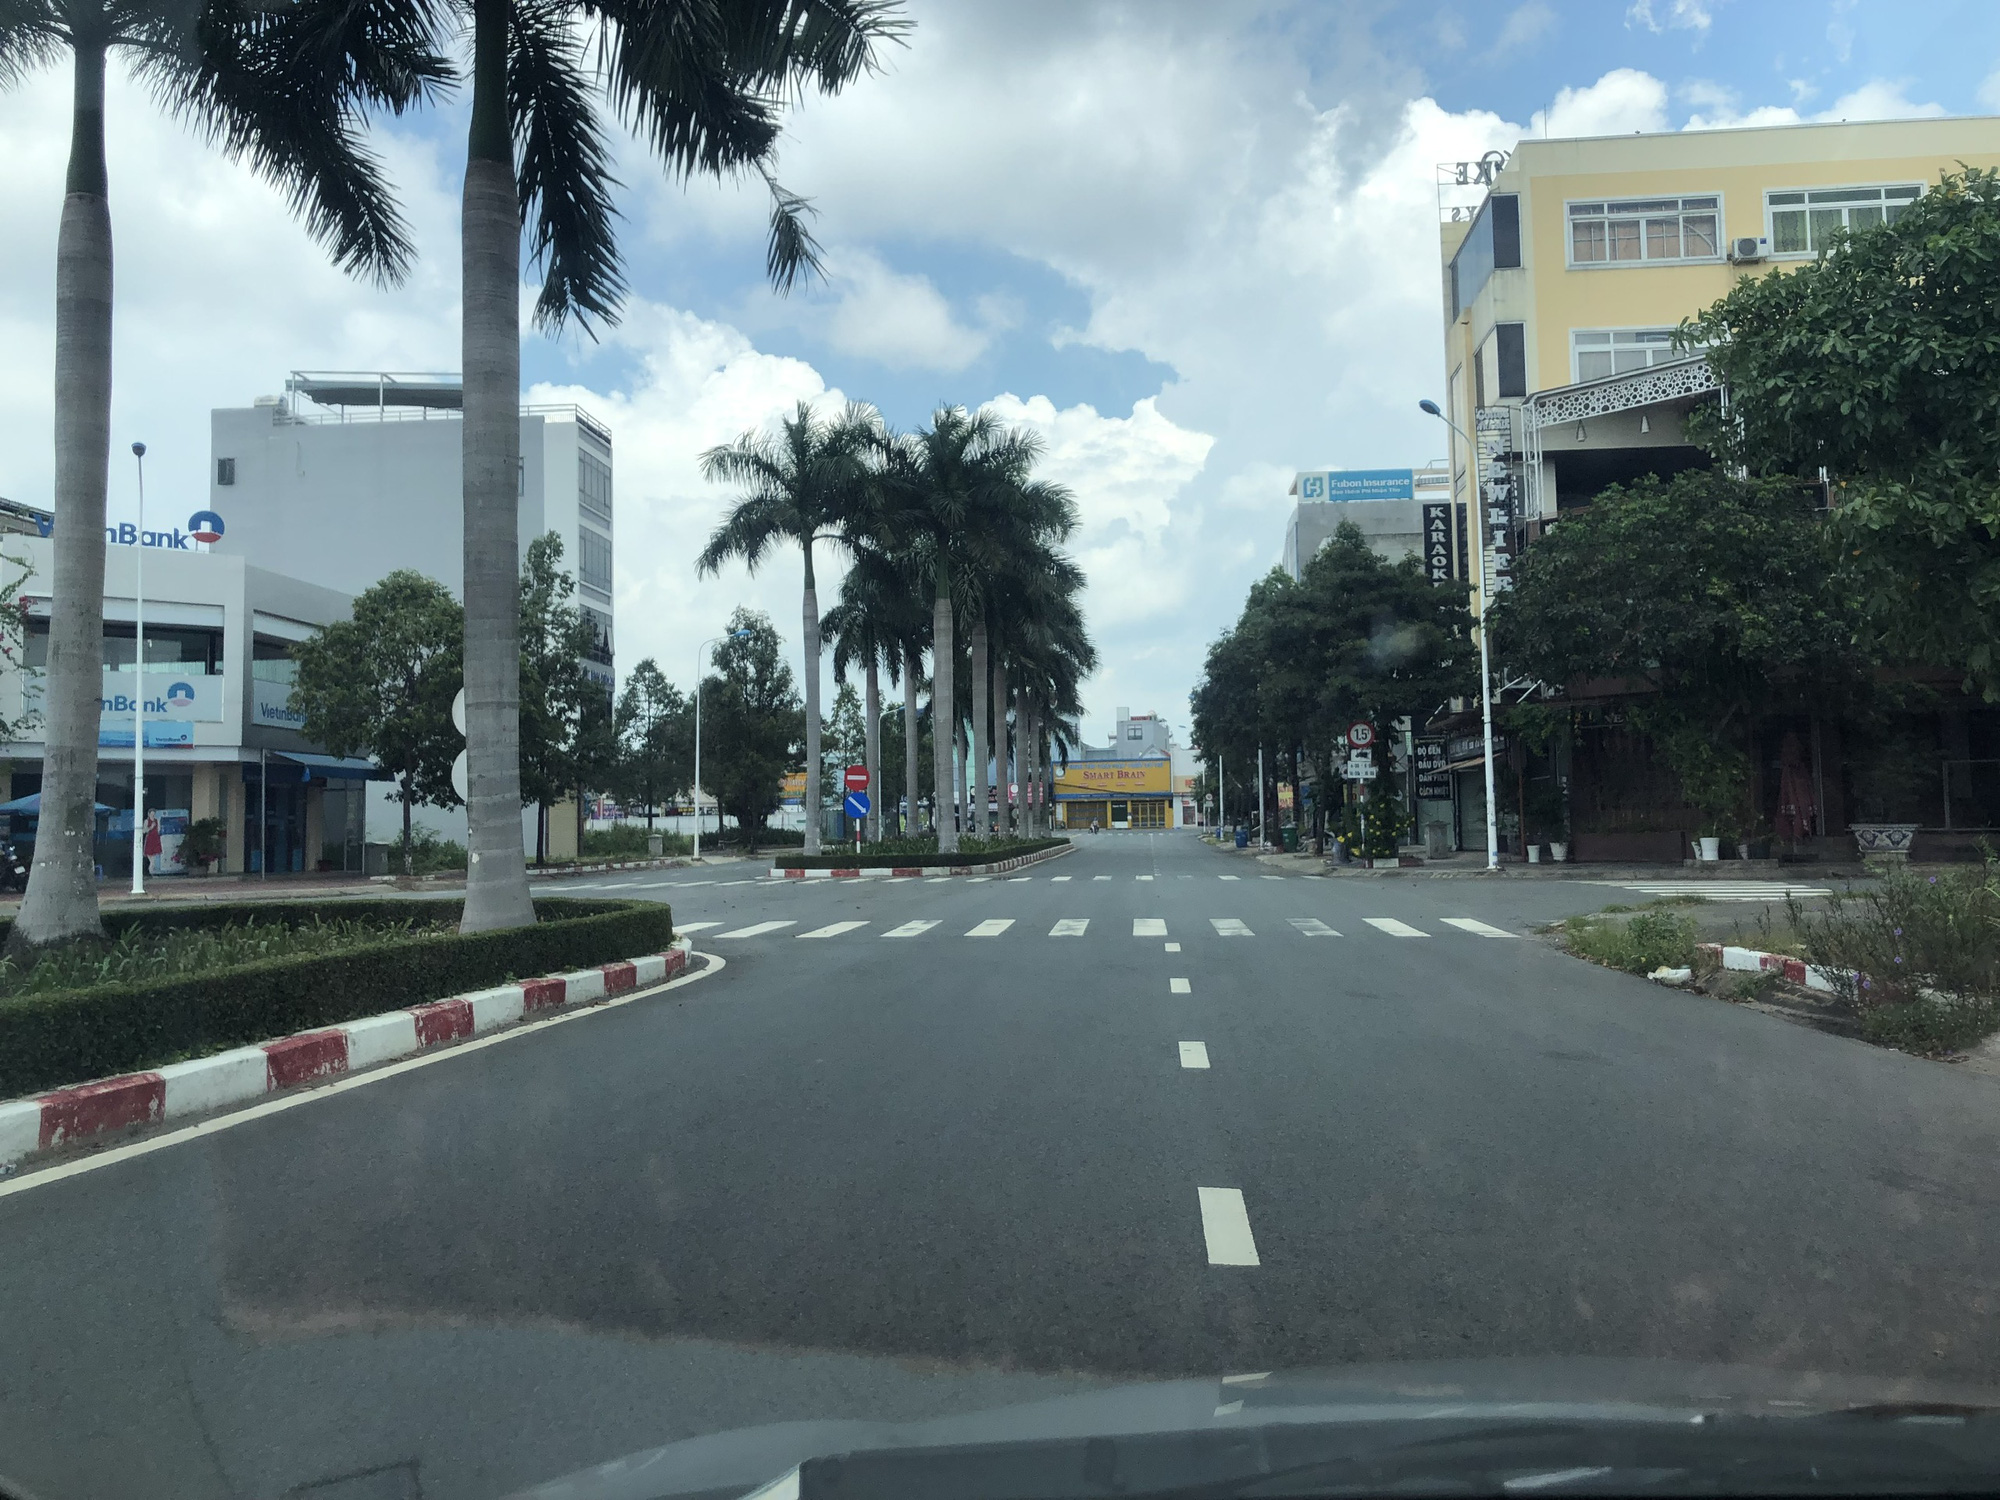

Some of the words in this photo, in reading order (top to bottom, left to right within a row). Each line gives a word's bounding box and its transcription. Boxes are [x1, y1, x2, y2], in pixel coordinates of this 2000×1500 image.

[1331, 479, 1361, 488] Fubon
[1363, 478, 1410, 487] Insurance
[33, 513, 189, 550] VnBank
[1083, 770, 1114, 780] SMART
[1117, 770, 1145, 779] BRAIN
